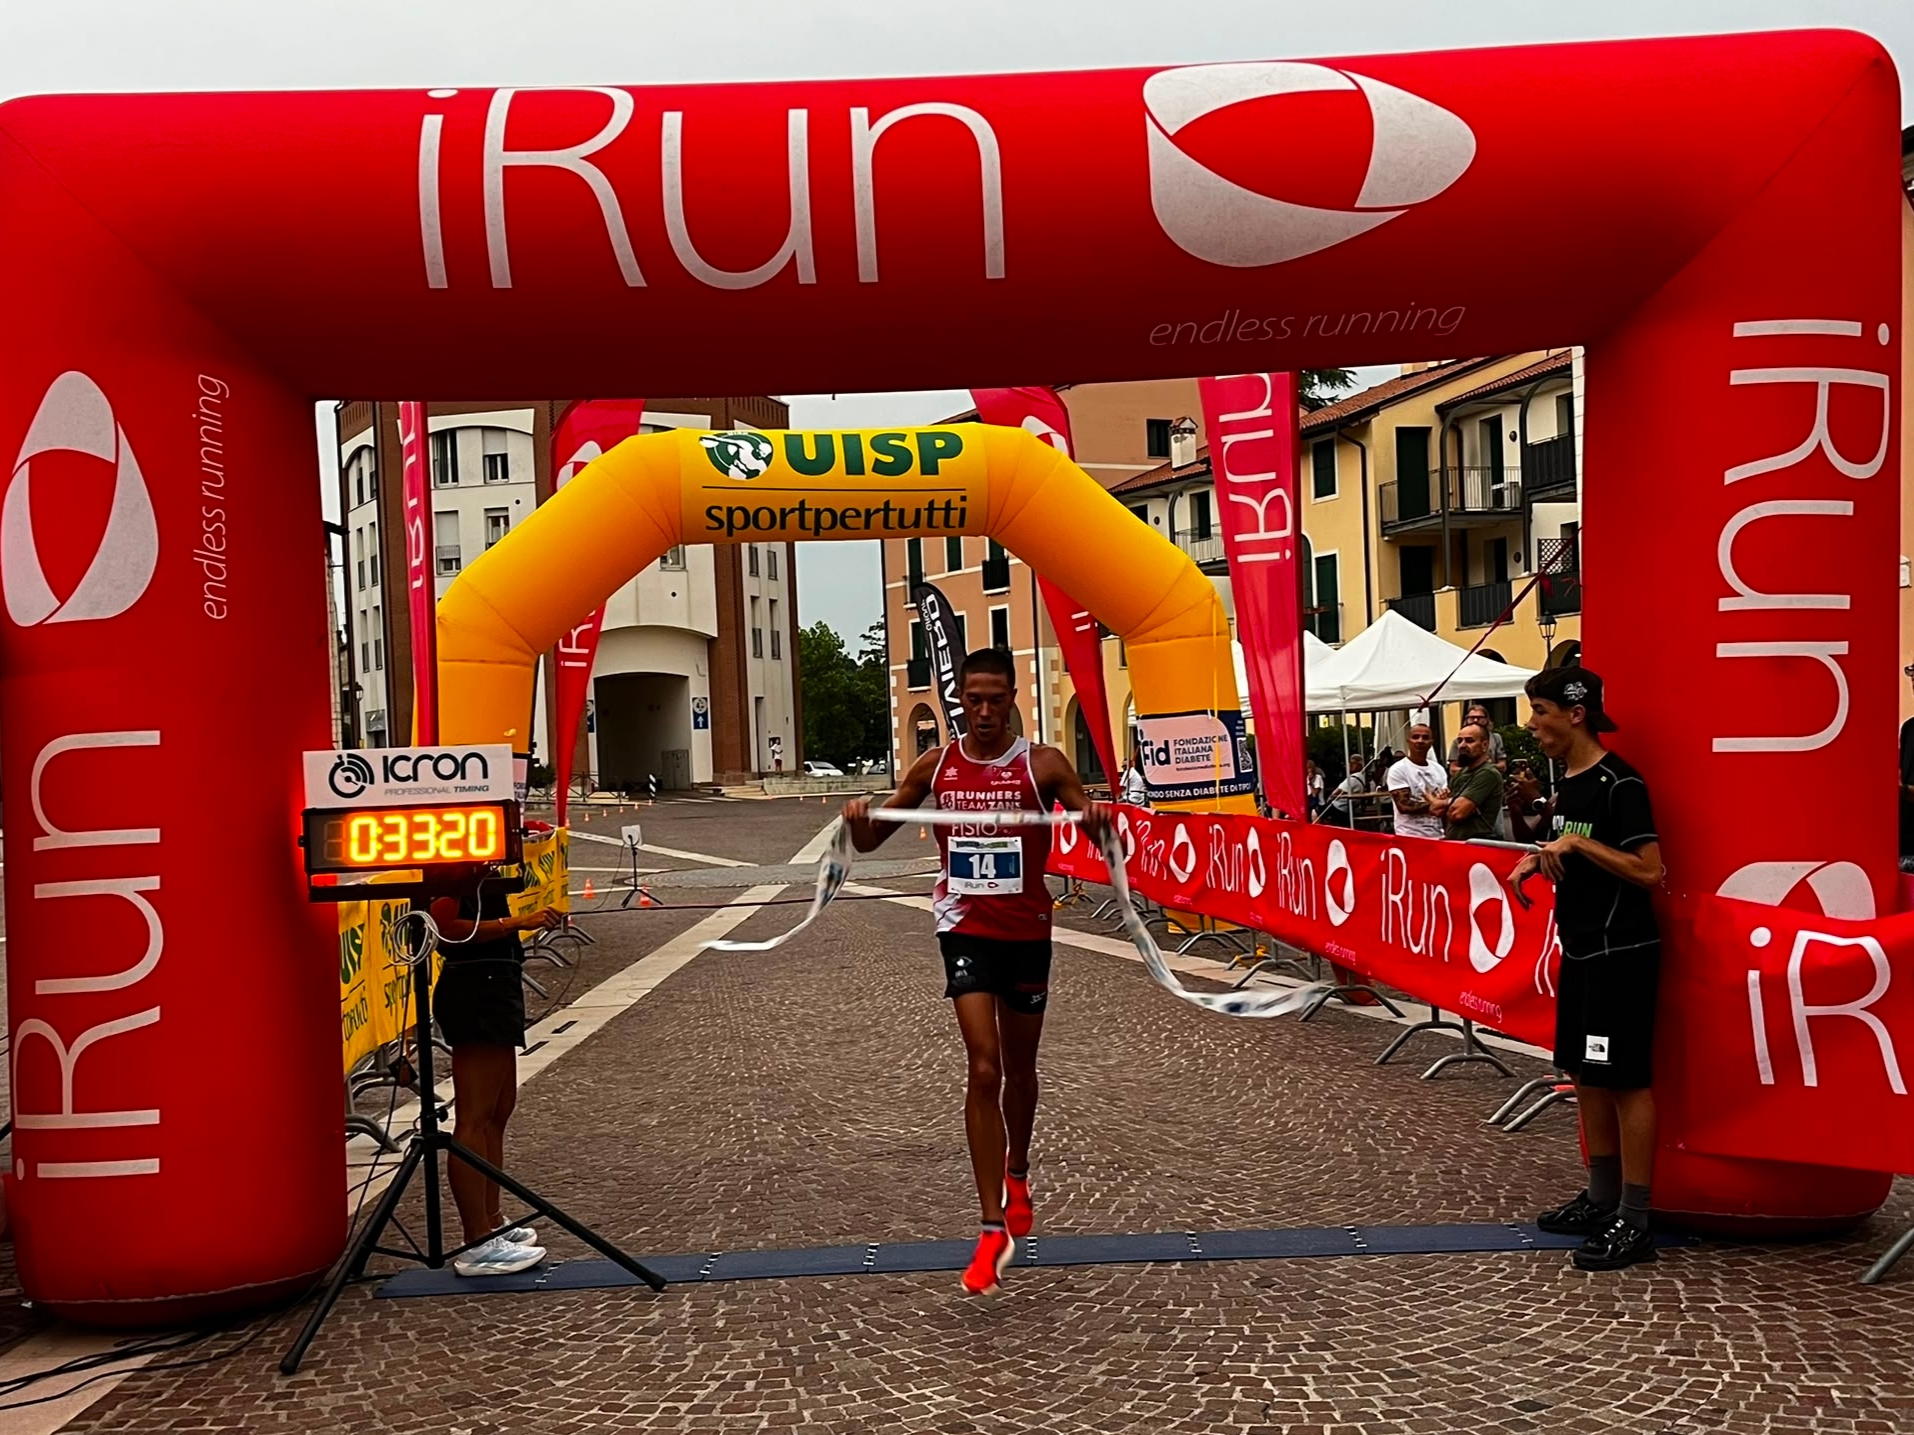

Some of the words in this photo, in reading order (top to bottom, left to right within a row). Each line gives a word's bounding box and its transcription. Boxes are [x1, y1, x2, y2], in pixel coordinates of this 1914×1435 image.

[418, 86, 1006, 290] iRun
[1149, 308, 1294, 347] endless
[1303, 301, 1466, 340] running
[192, 373, 230, 500] running
[783, 431, 963, 477] UISP
[705, 494, 967, 538] sportpertutti
[1712, 318, 1890, 754] iRun
[193, 506, 228, 620] endless
[1142, 739, 1172, 766] fid
[1173, 735, 1228, 747] FONDAZIONE
[1174, 745, 1214, 756] ITALIANA
[1175, 754, 1211, 765] DIABETE
[384, 786, 451, 796] PROFESSIONAL
[454, 784, 490, 793] TIMING
[956, 791, 1022, 800] RUNNERS
[1165, 788, 1192, 798] SENZA
[1193, 784, 1229, 796] DIABTE
[350, 810, 497, 863] 0:33:20
[1206, 824, 1245, 894] iRun
[968, 854, 997, 879] 14
[1277, 831, 1316, 920] iRun
[1380, 847, 1453, 962] iRun
[14, 730, 164, 1181] iRun
